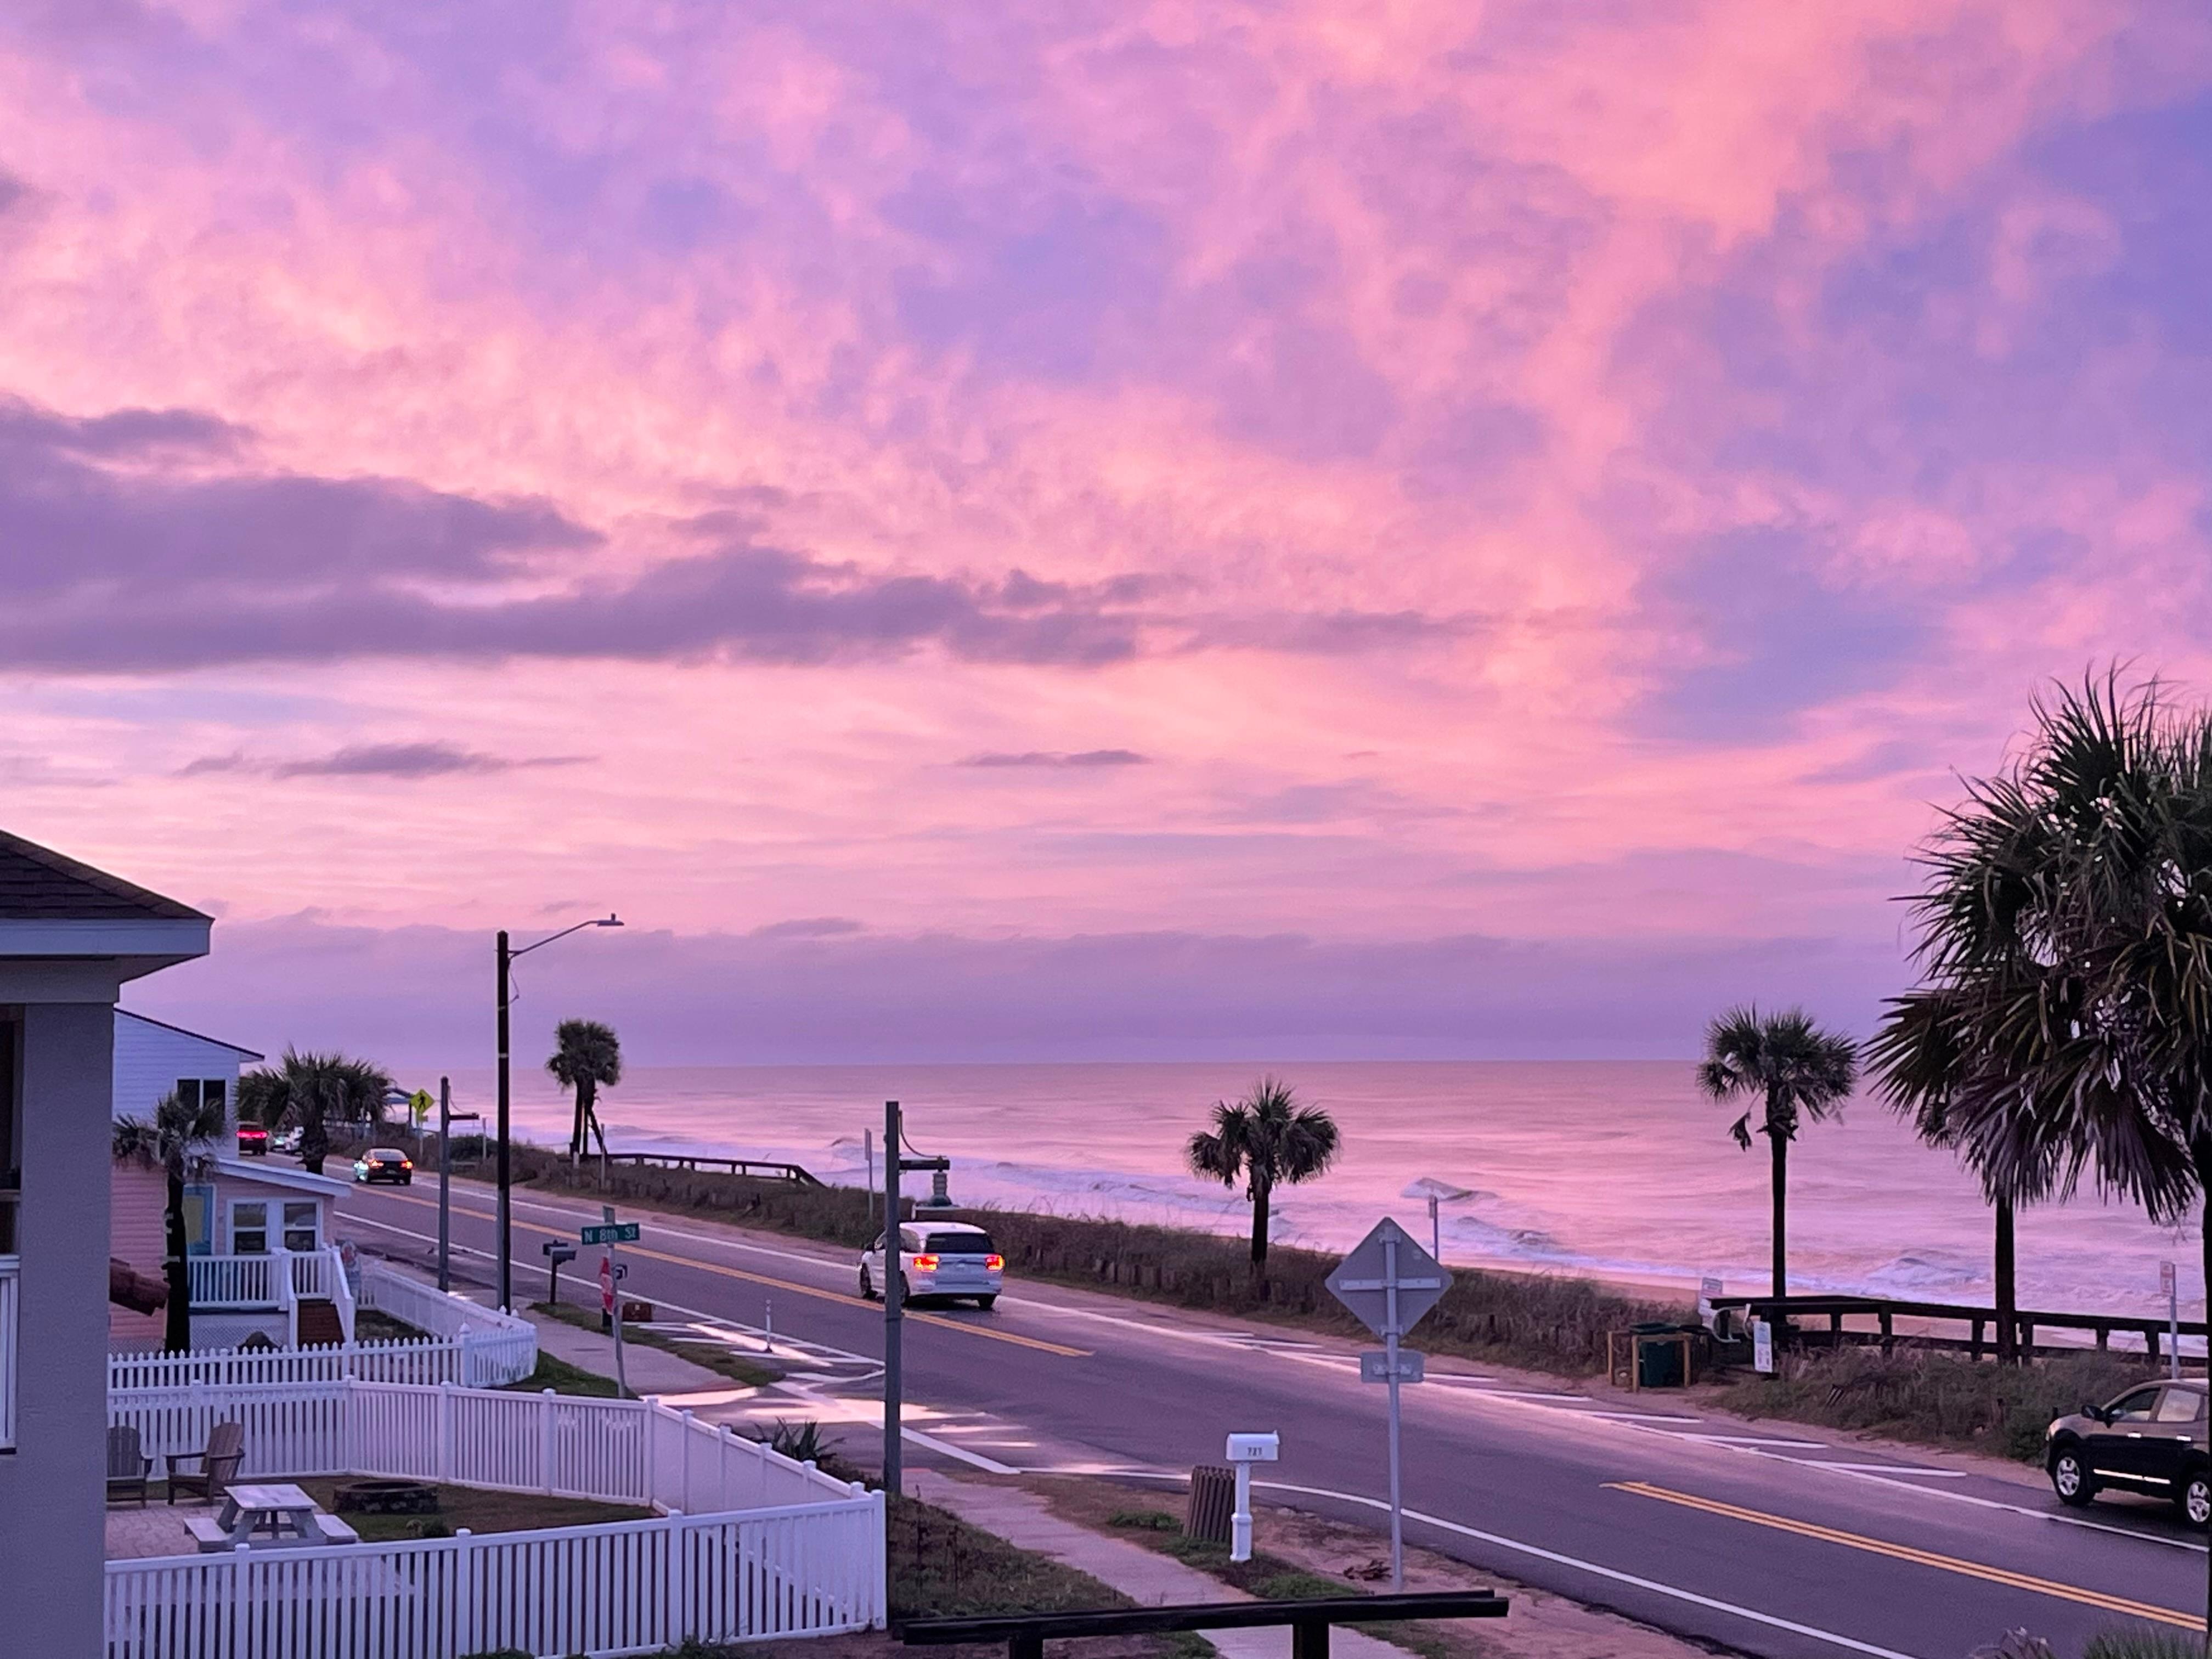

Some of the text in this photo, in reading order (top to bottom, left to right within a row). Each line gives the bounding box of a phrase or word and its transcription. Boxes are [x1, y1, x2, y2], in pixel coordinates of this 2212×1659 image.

[584, 1226, 636, 1242] N 8th St
